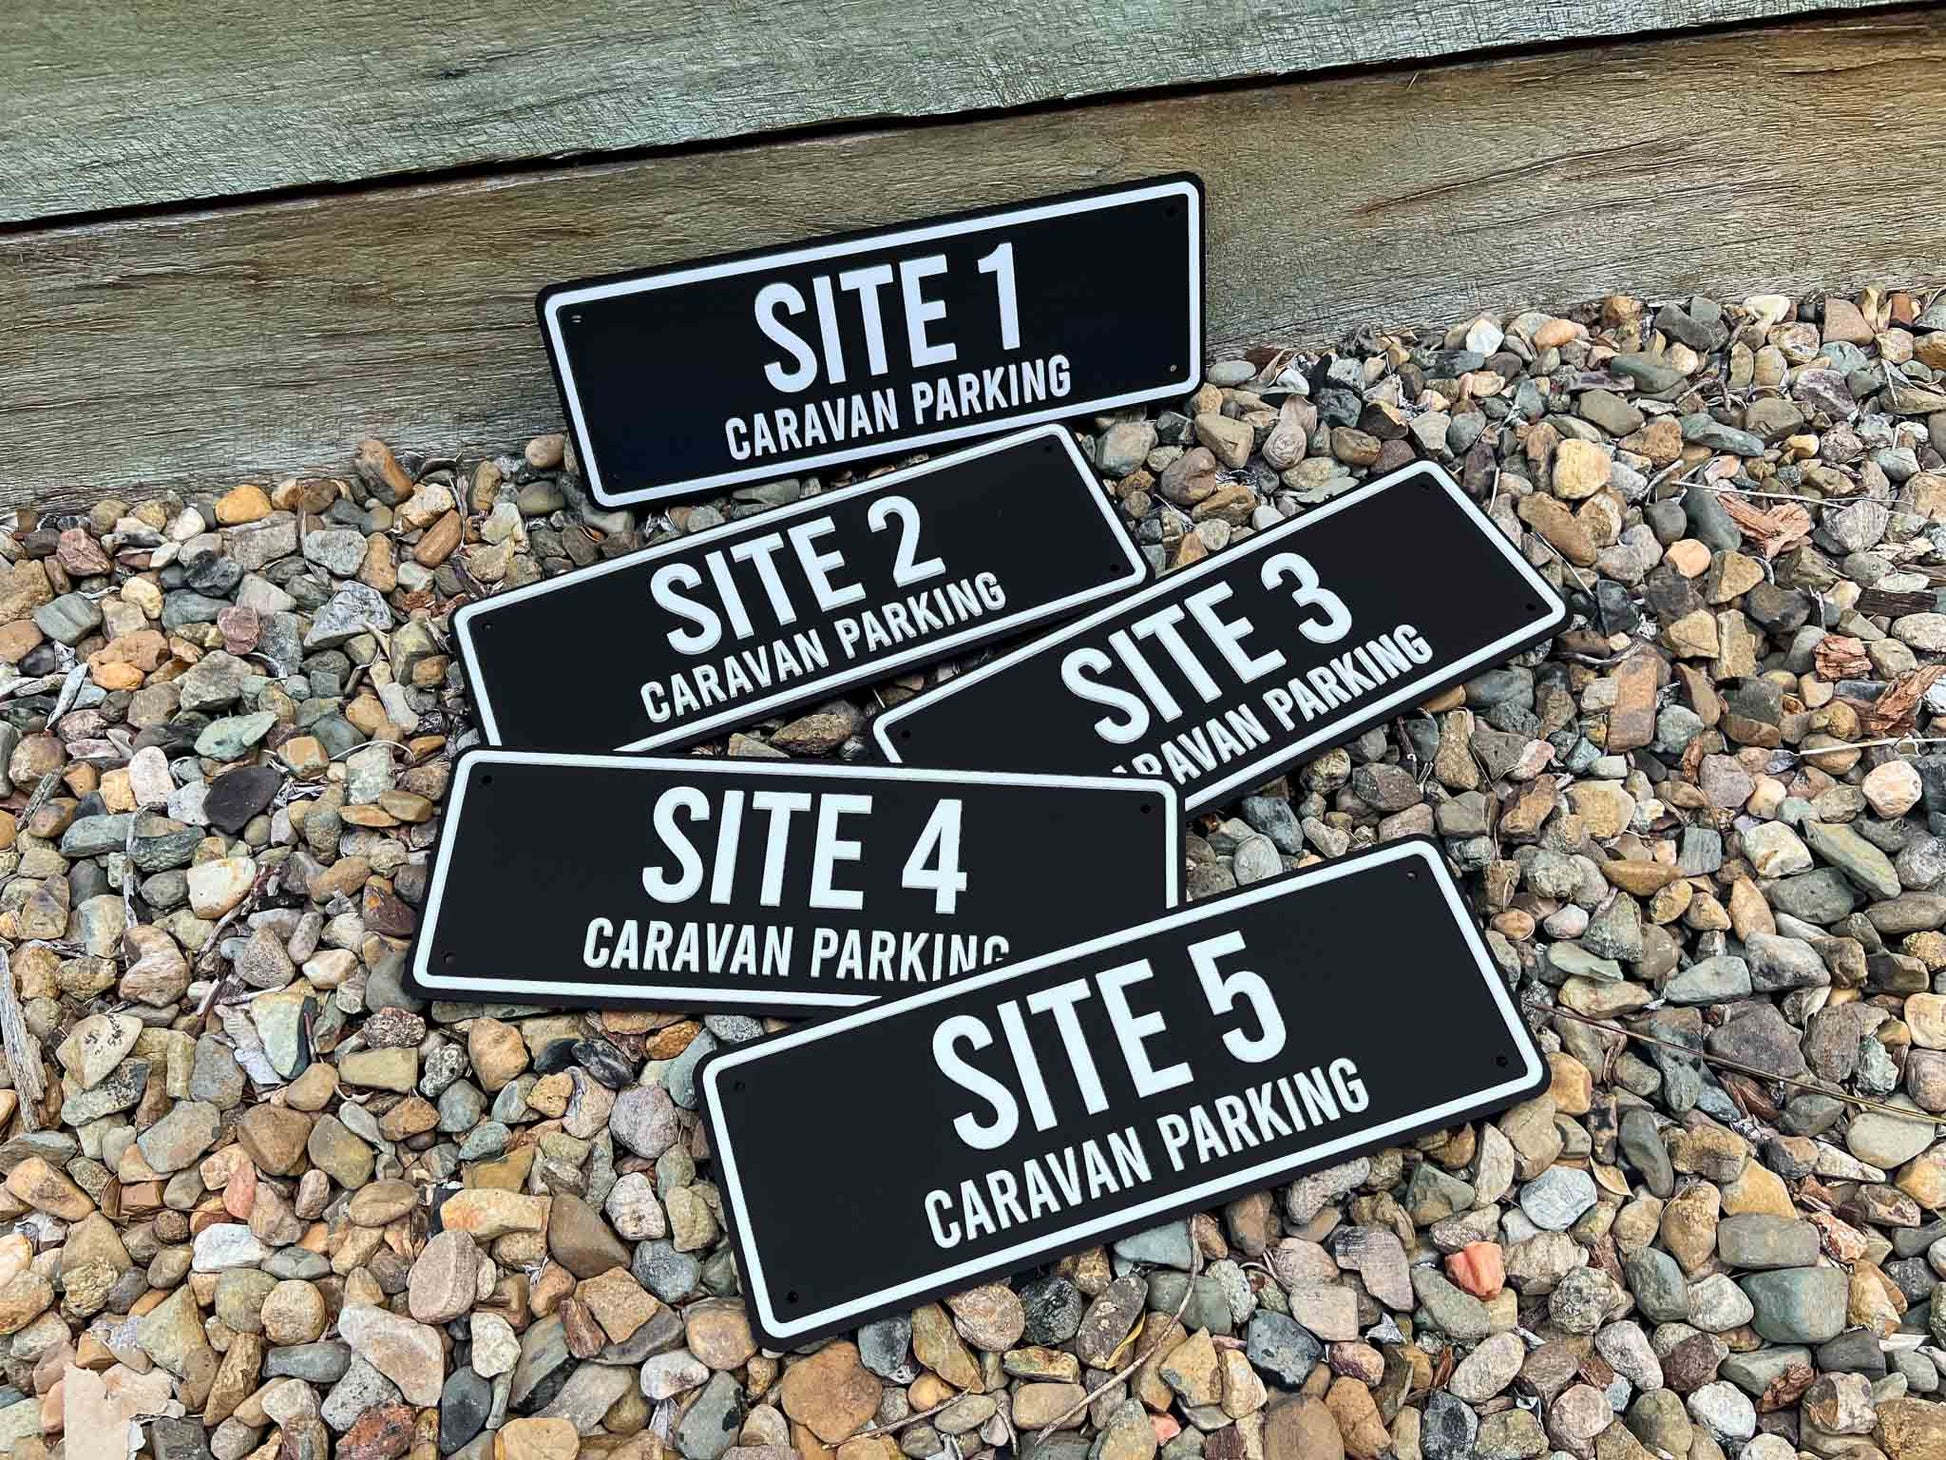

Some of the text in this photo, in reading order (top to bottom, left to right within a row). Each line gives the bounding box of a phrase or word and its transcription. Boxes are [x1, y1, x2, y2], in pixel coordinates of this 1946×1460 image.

[755, 243, 1020, 392] SITE 1
[725, 354, 1071, 460] CARAVAN PARKING
[640, 571, 1006, 723] CARAVAN PARKING
[650, 496, 946, 655] SITE 2
[1061, 552, 1352, 744] SITE 3
[1262, 624, 1433, 732] PARKING
[642, 786, 968, 915] SITE 4
[583, 917, 794, 978] CARAVAN
[932, 930, 1287, 1150] SITE 5
[924, 1057, 1369, 1249] CARAVAN PARKING
